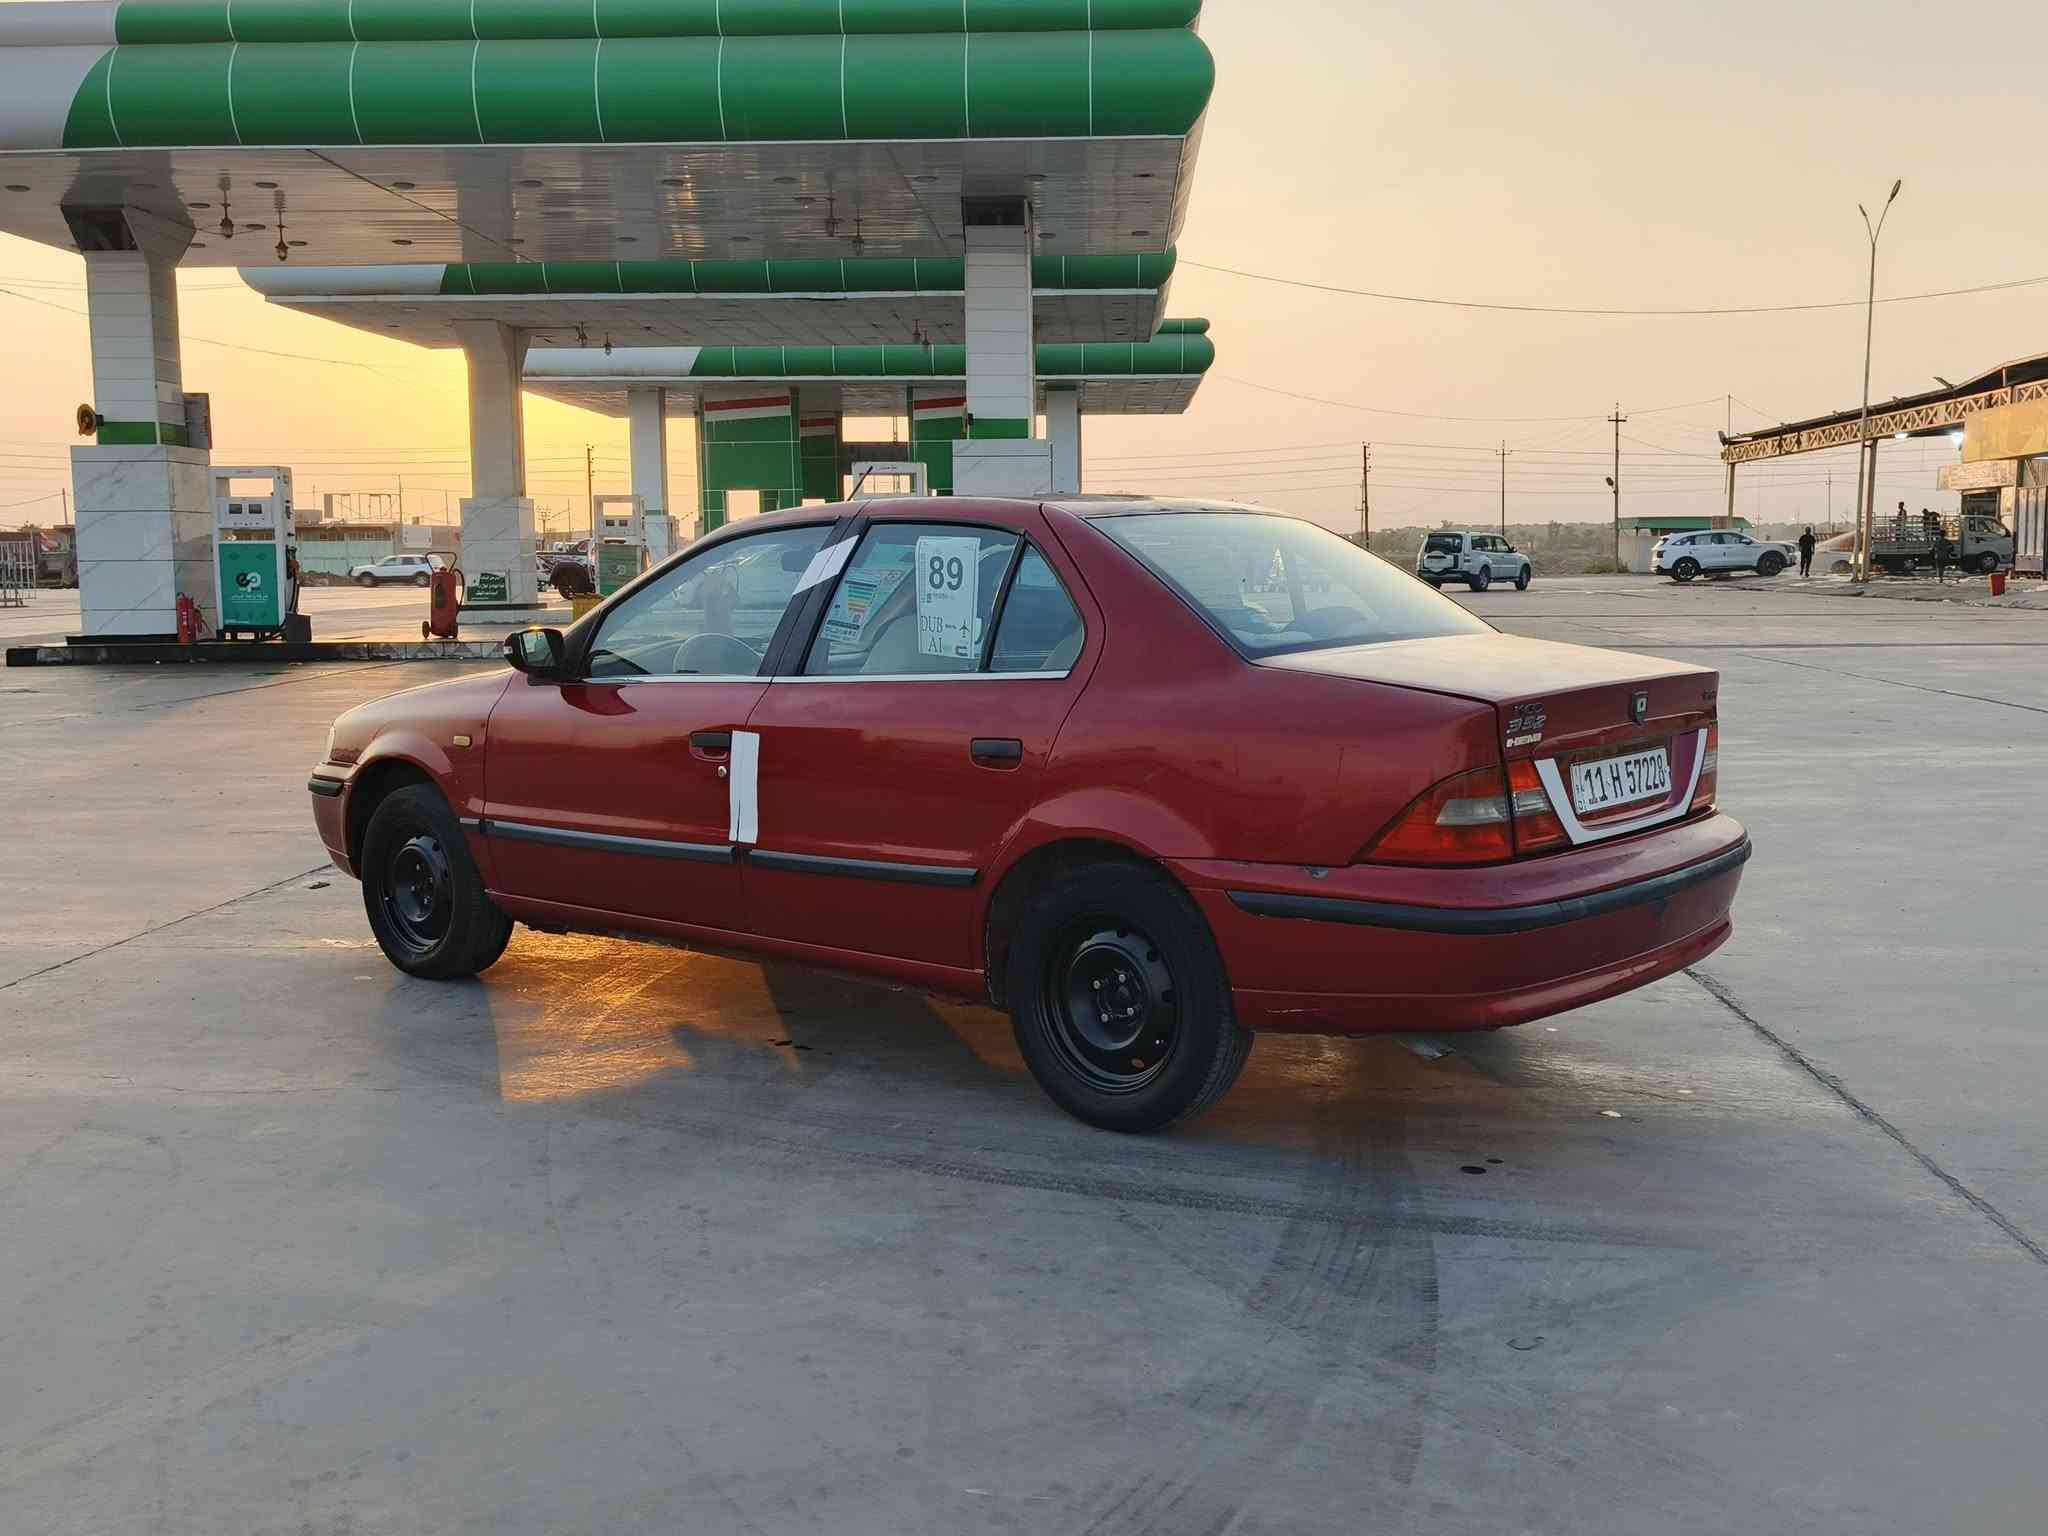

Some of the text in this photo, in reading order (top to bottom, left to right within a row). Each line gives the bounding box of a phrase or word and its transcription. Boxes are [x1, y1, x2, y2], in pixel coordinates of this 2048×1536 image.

[929, 556, 963, 591] 89
[1585, 766, 1608, 804] 11
[1609, 762, 1623, 798] H
[1624, 754, 1666, 794] 57228
